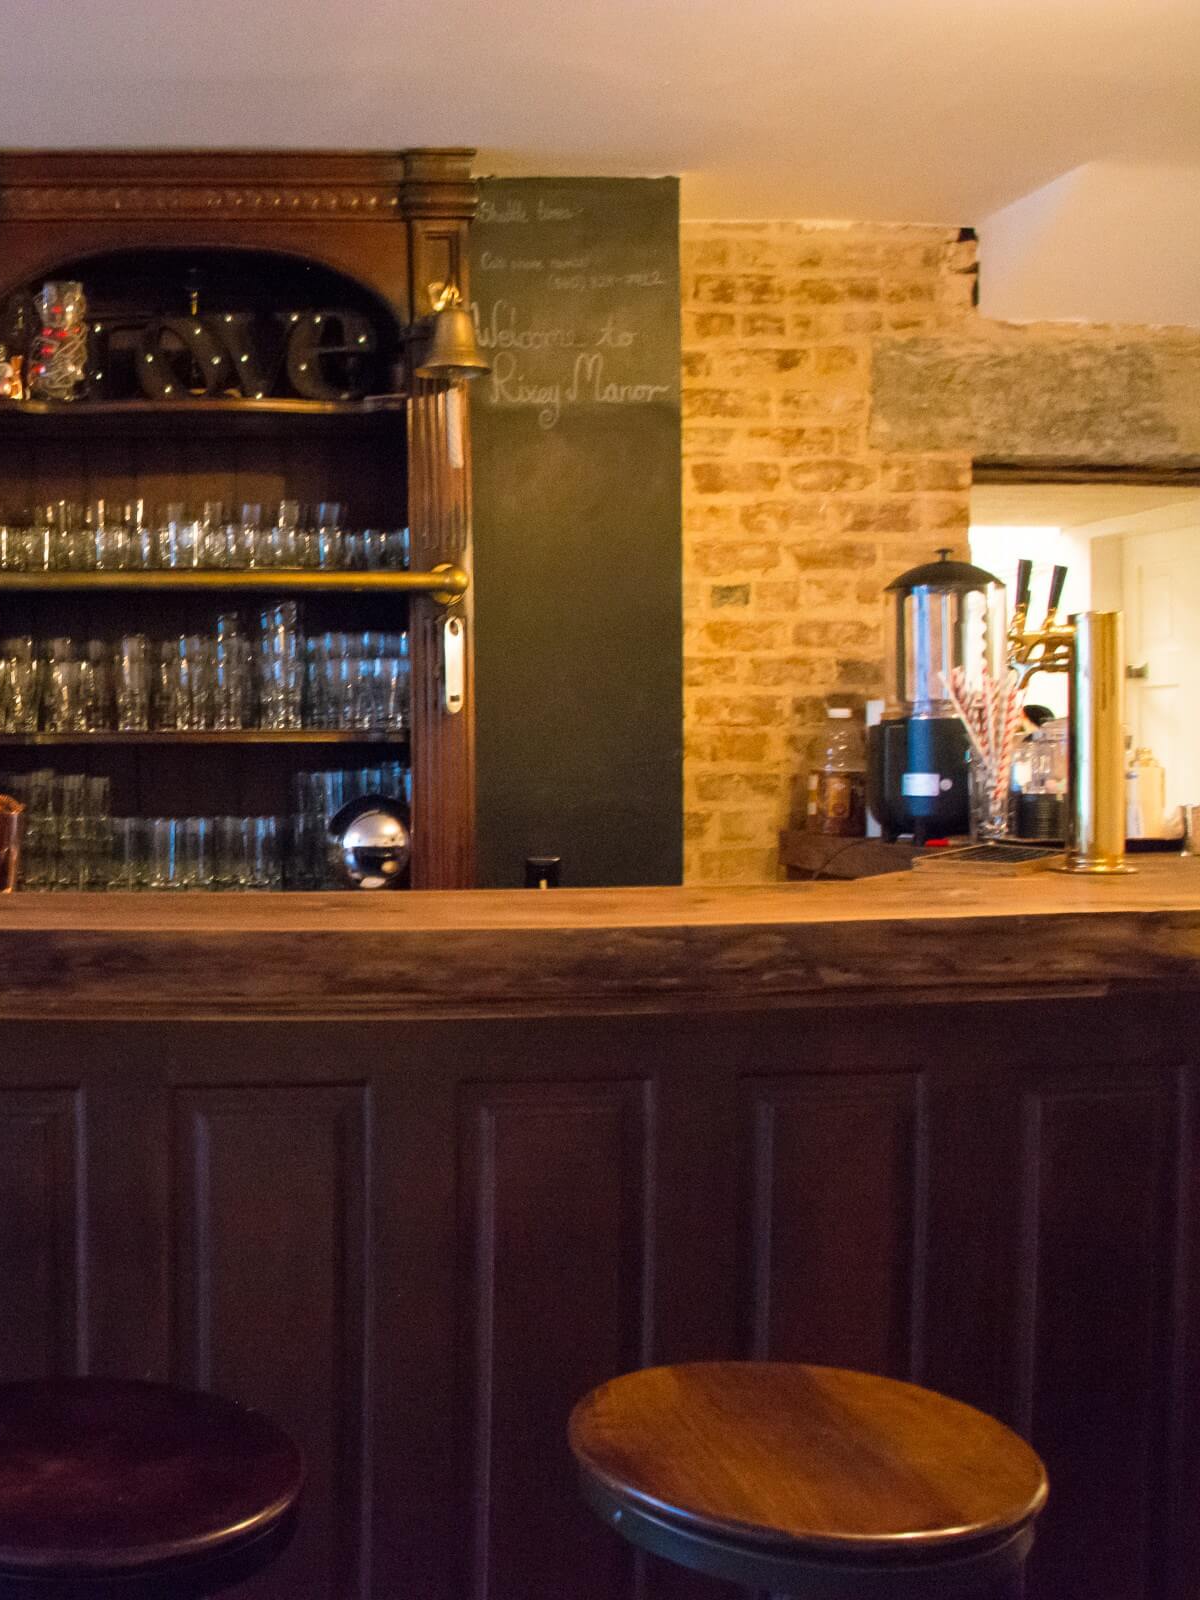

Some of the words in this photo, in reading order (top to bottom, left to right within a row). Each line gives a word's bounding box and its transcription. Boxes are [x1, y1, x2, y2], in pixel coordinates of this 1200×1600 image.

[471, 298, 586, 349] Welcome
[596, 313, 639, 349] to
[490, 350, 561, 431] Rixey
[565, 351, 671, 403] Manor
